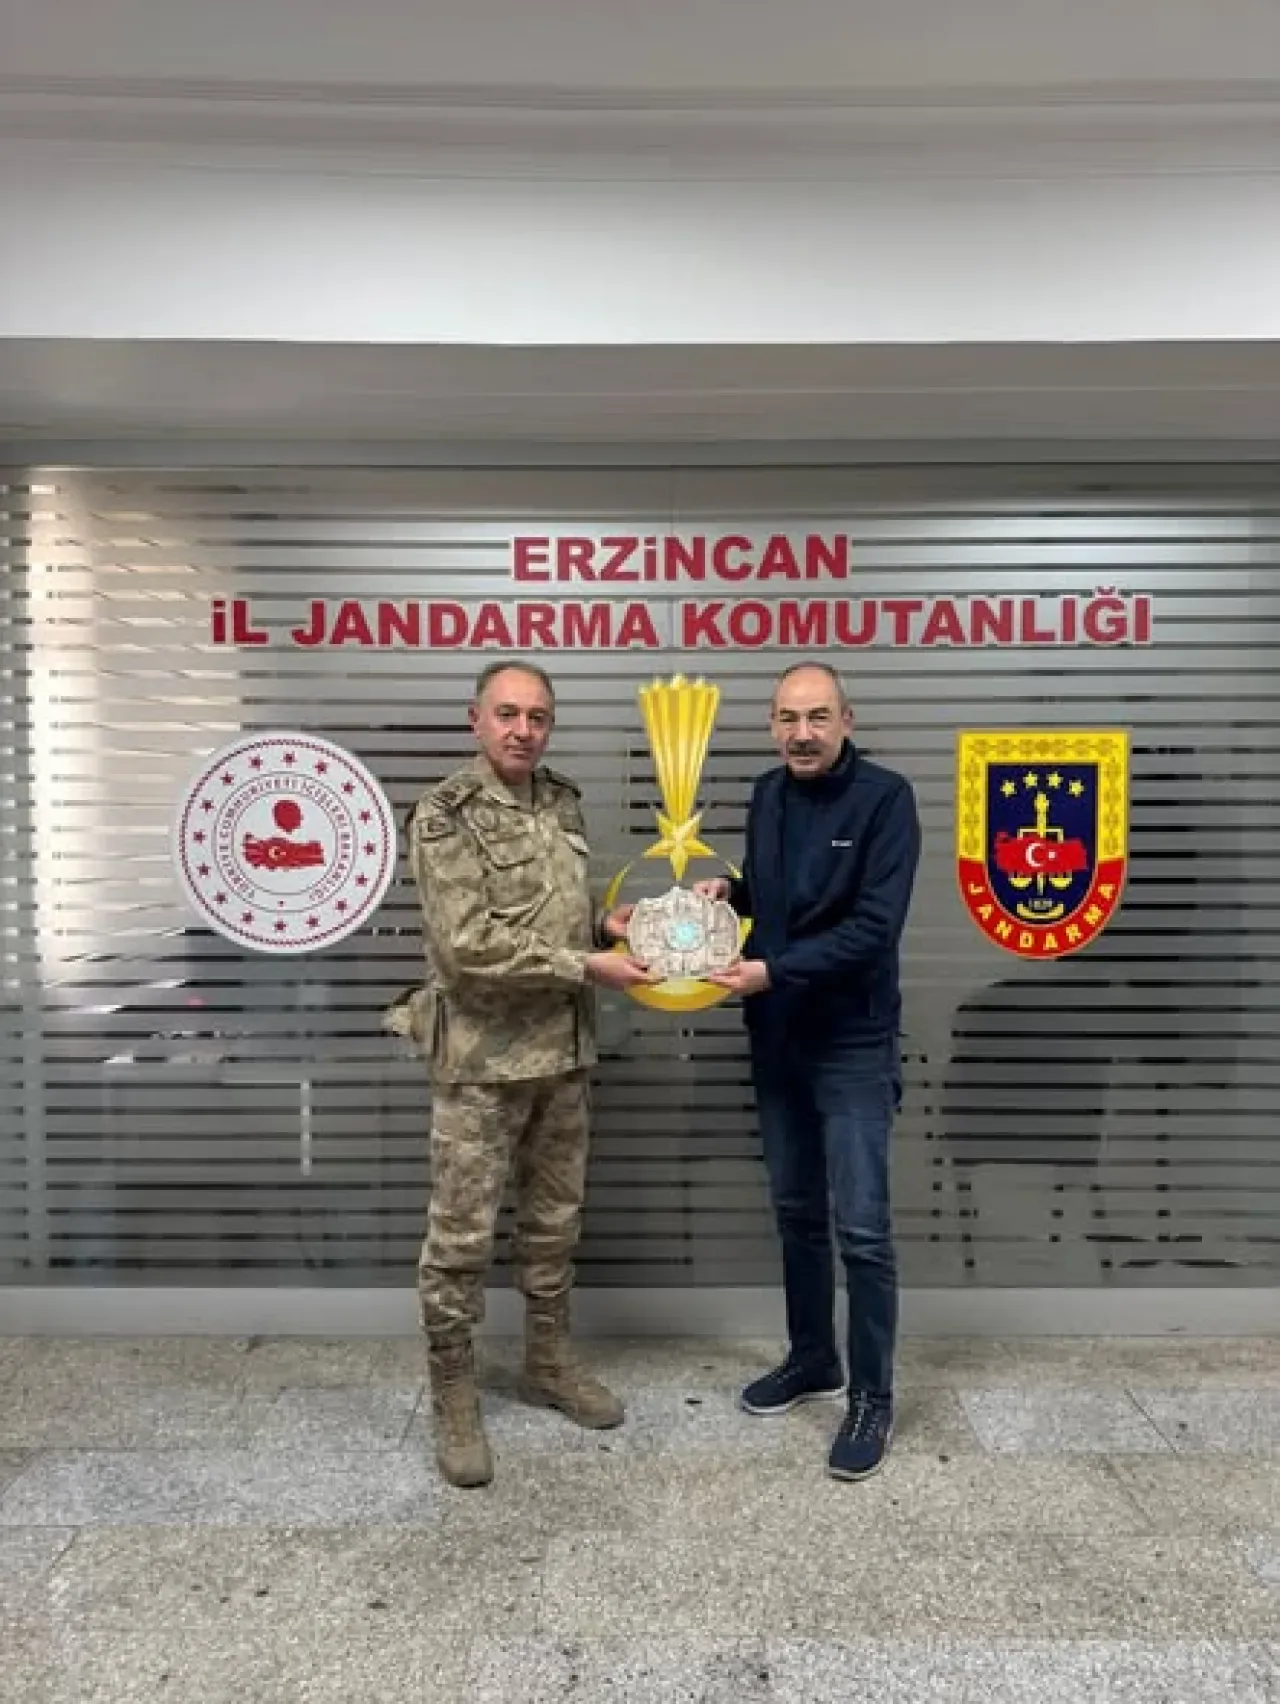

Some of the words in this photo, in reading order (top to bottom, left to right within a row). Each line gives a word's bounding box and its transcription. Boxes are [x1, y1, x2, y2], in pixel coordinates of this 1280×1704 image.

[292, 600, 658, 647] JANDARMA
[682, 586, 1150, 647] KOMUTANLIĞI
[967, 882, 1115, 951] JANDARMA
